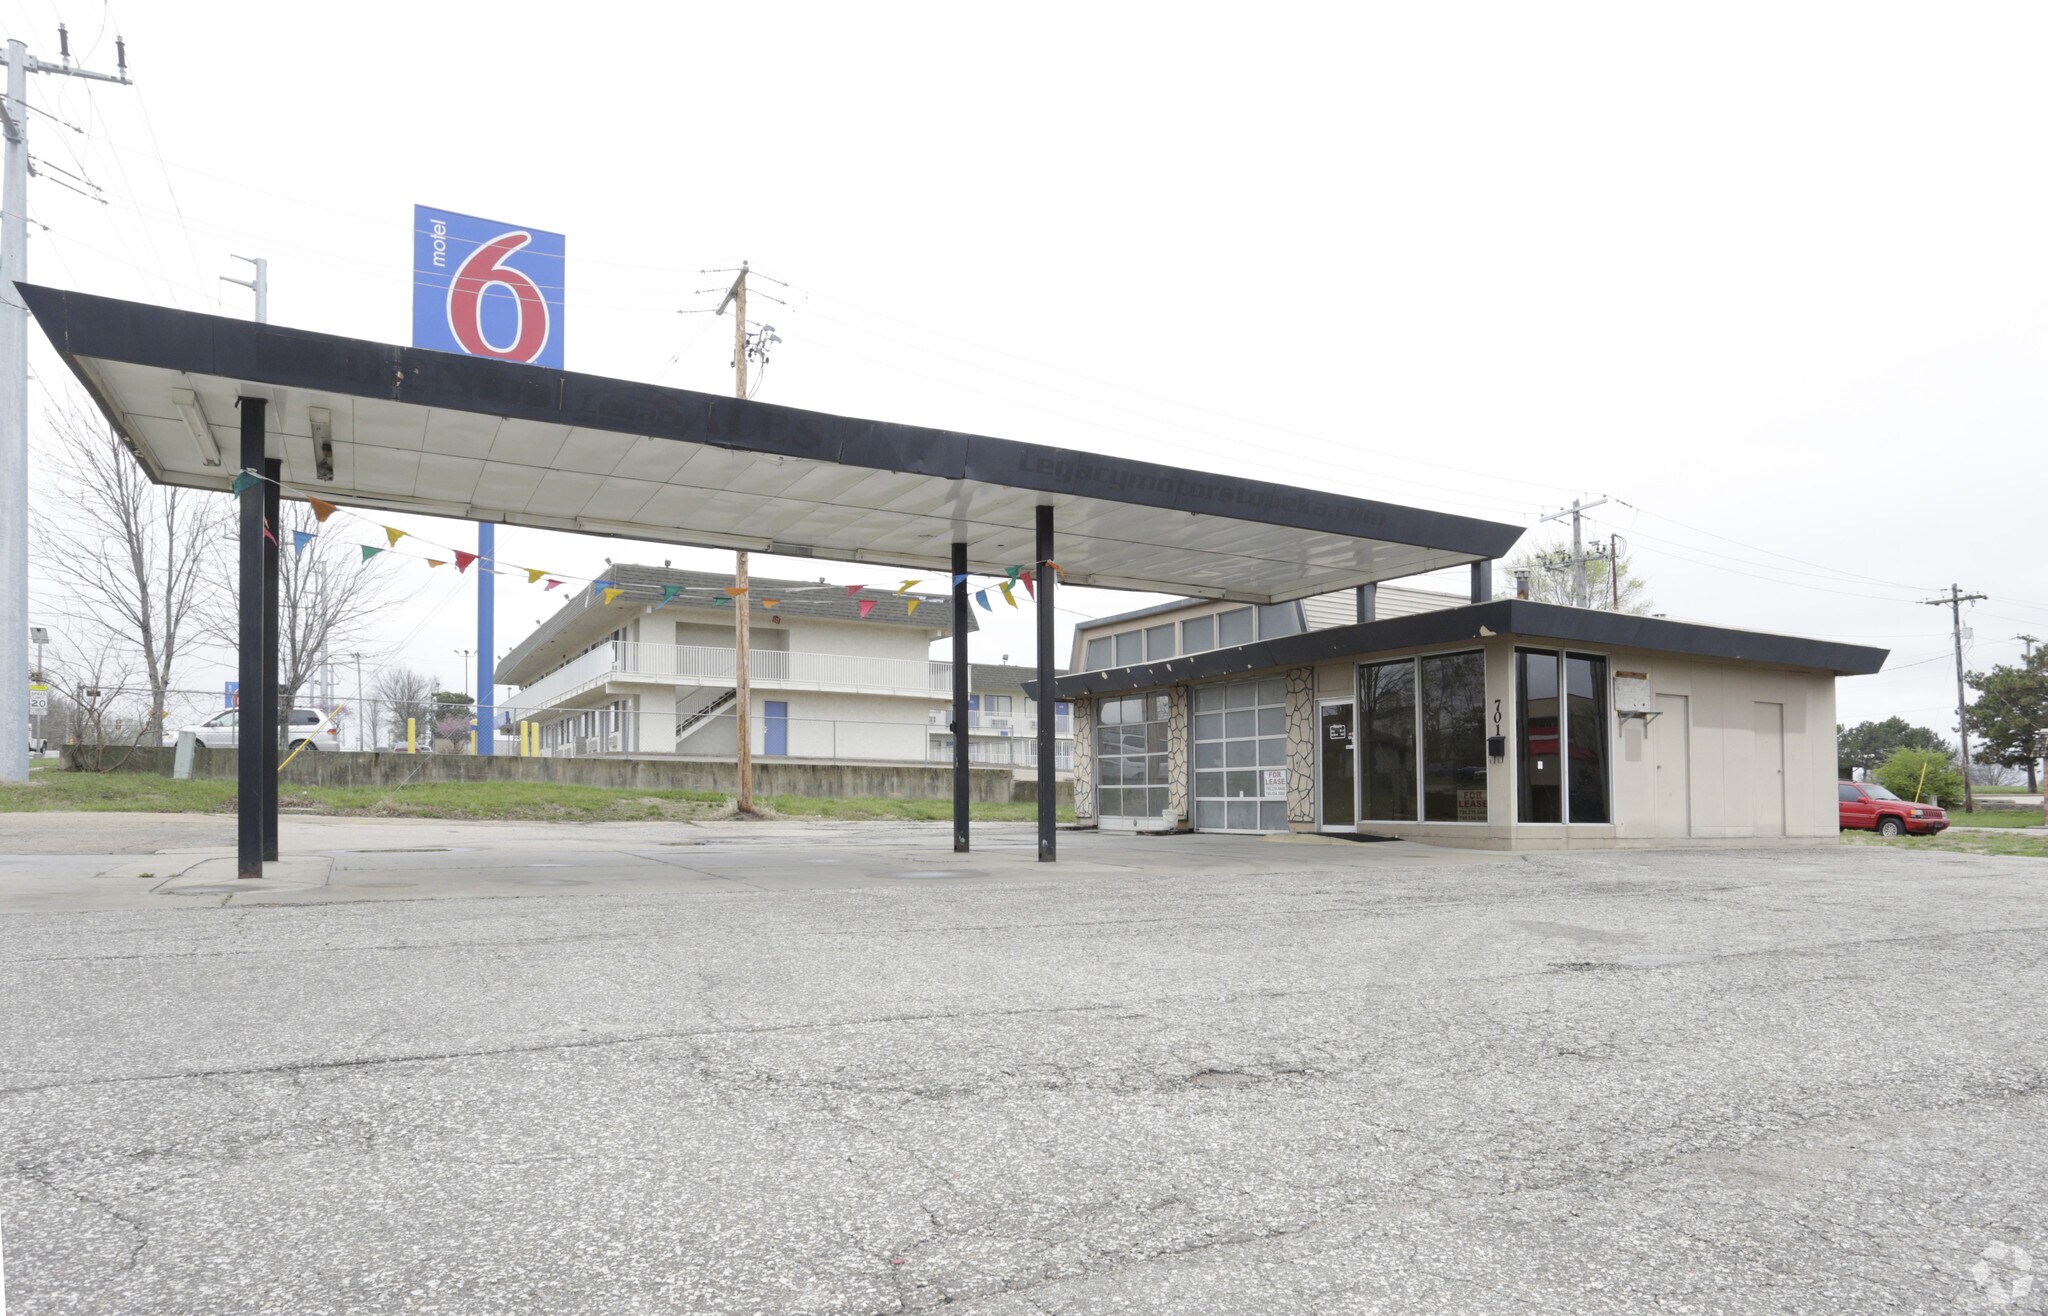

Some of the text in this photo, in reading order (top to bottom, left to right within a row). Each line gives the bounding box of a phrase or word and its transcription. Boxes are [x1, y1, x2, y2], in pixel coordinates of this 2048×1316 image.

[430, 219, 446, 267] motel
[446, 230, 550, 363] 6
[1493, 699, 1502, 736] 701
[1464, 791, 1482, 799] FOR
